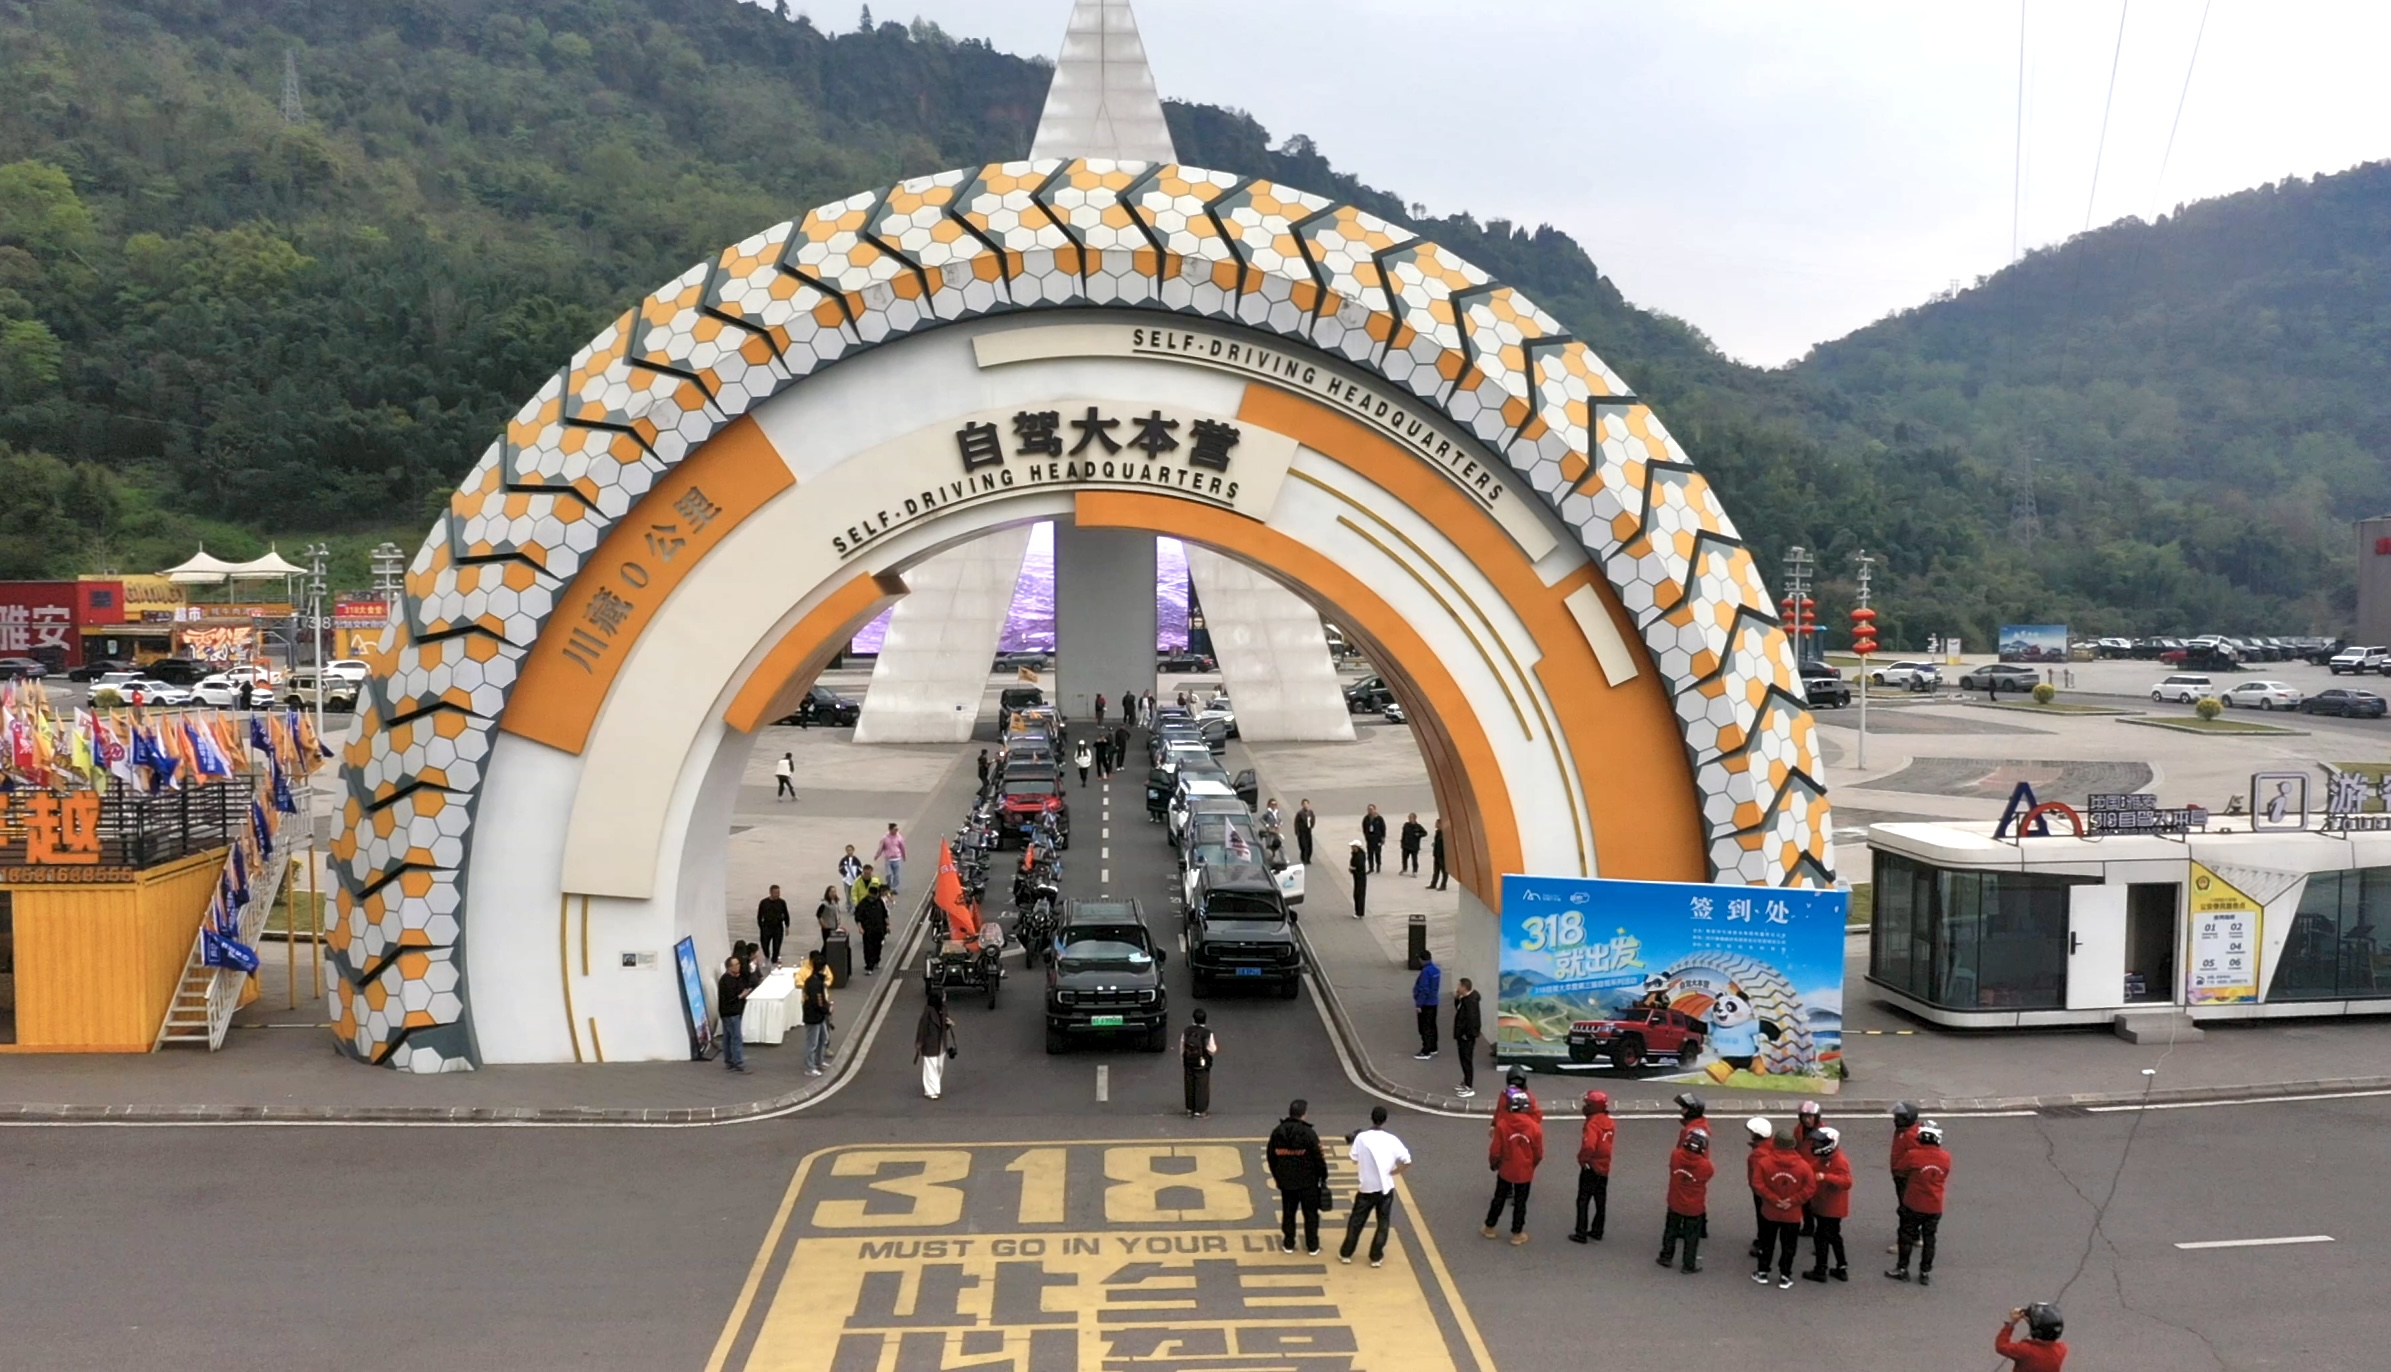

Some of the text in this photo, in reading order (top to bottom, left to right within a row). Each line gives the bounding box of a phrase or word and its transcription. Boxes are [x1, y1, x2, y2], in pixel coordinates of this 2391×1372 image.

[956, 406, 1241, 473] 自驾大本营
[1327, 377, 1503, 501] HEADQUARTERS
[1030, 461, 1239, 499] HEADQUARTERS
[174, 606, 202, 622] 超市
[308, 616, 331, 629] 38
[2330, 773, 2391, 813] 游
[0, 790, 101, 864] 越
[1689, 896, 1789, 924] 签到处
[2230, 922, 2242, 931] 02
[1520, 910, 1587, 952] 318
[2204, 923, 2216, 931] 01
[1555, 935, 1646, 980] 就出发
[2202, 959, 2215, 967] 05
[2229, 942, 2242, 951] 04
[2229, 958, 2241, 967] 06
[811, 1145, 1253, 1229] 318
[858, 1240, 975, 1259] MUST
[991, 1238, 1046, 1256] GO
[1062, 1237, 1100, 1255] IN
[1117, 1235, 1237, 1254] YOUR
[843, 1258, 1341, 1328] 此生
